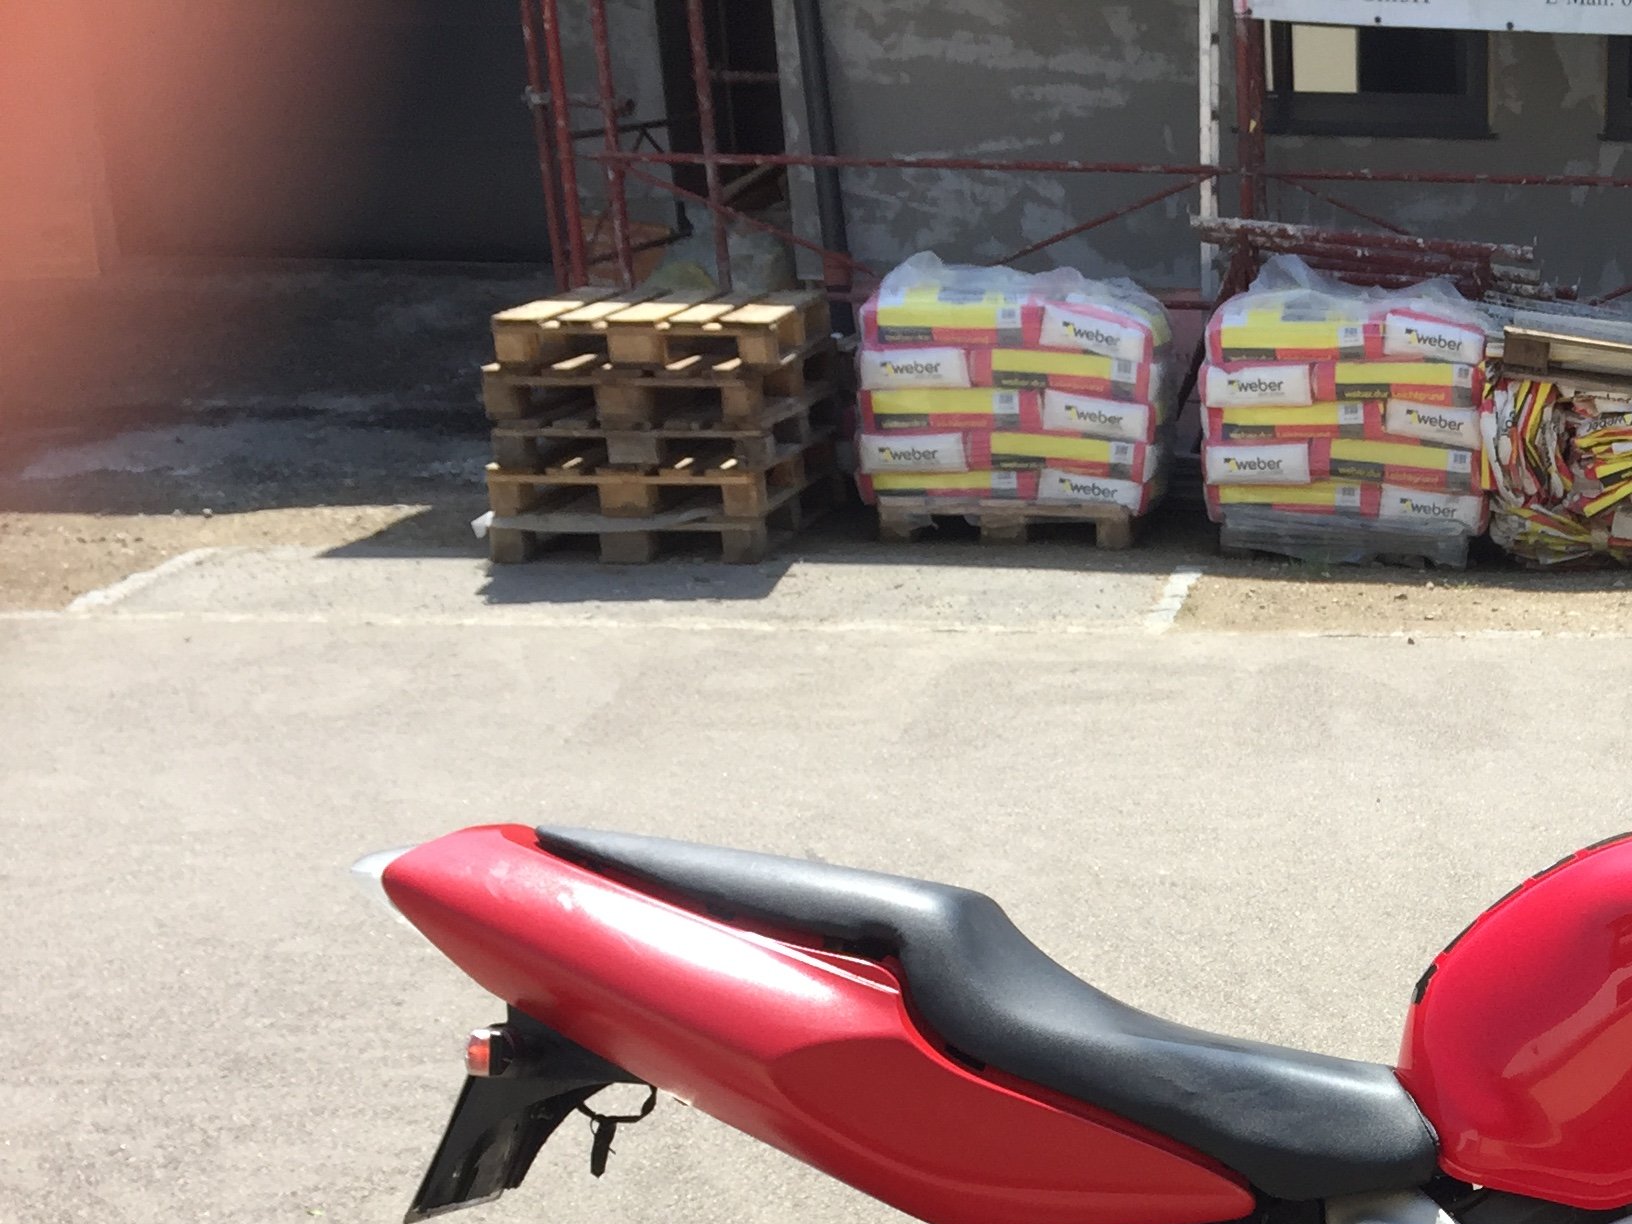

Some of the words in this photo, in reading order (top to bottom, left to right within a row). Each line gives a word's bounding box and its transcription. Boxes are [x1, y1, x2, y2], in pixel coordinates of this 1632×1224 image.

[1072, 324, 1121, 347] weber
[1415, 332, 1463, 352] weber
[892, 360, 941, 376] weber
[1238, 379, 1284, 393] weber
[1075, 408, 1124, 426] weber
[1417, 413, 1465, 432] weber
[890, 447, 938, 462] weber
[1235, 457, 1283, 472] weber
[1071, 481, 1118, 499] weber
[1411, 501, 1457, 519] weber
